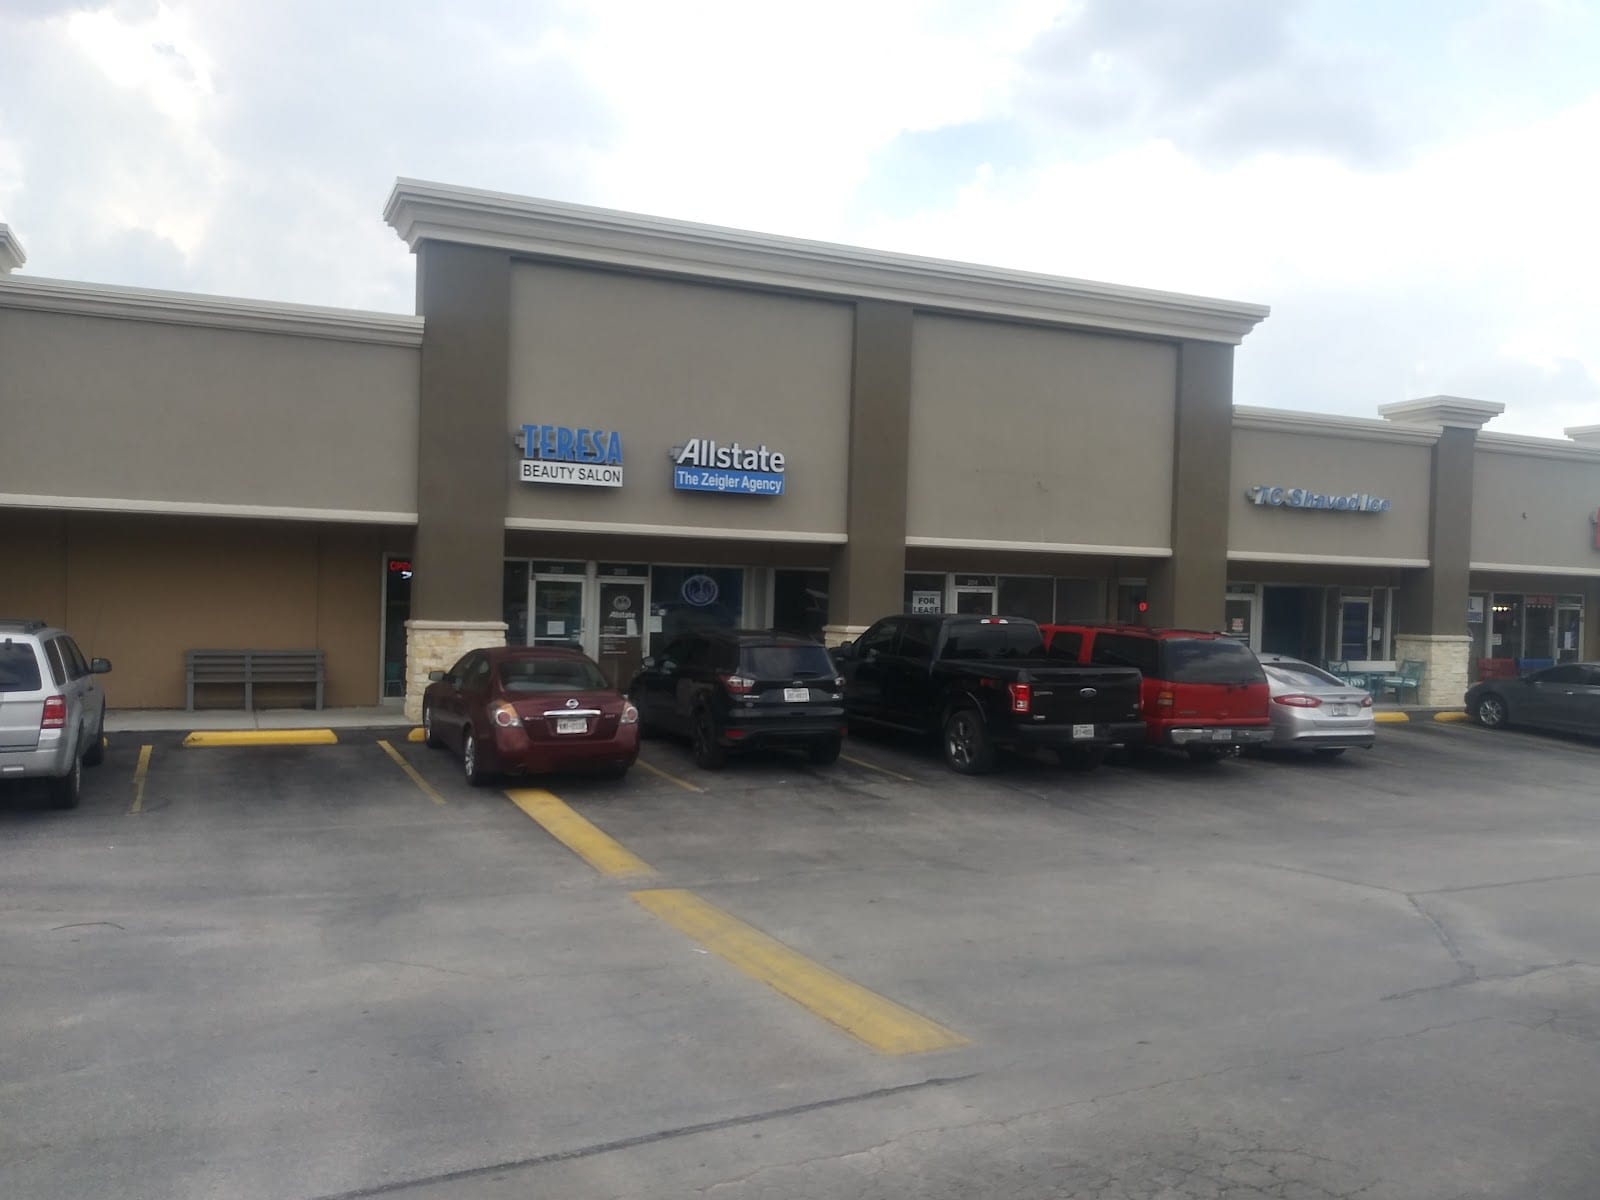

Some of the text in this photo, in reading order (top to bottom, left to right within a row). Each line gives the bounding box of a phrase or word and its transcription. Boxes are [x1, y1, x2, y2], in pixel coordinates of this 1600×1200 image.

[521, 424, 622, 463] TERESA
[676, 438, 785, 472] Allstate
[523, 464, 621, 482] BEAUTY SALON
[678, 471, 782, 493] The Zeigler Agency
[1289, 488, 1359, 510] Shaved
[1361, 494, 1391, 512] Ice
[913, 606, 940, 614] LEASE
[918, 597, 935, 605] FOR
